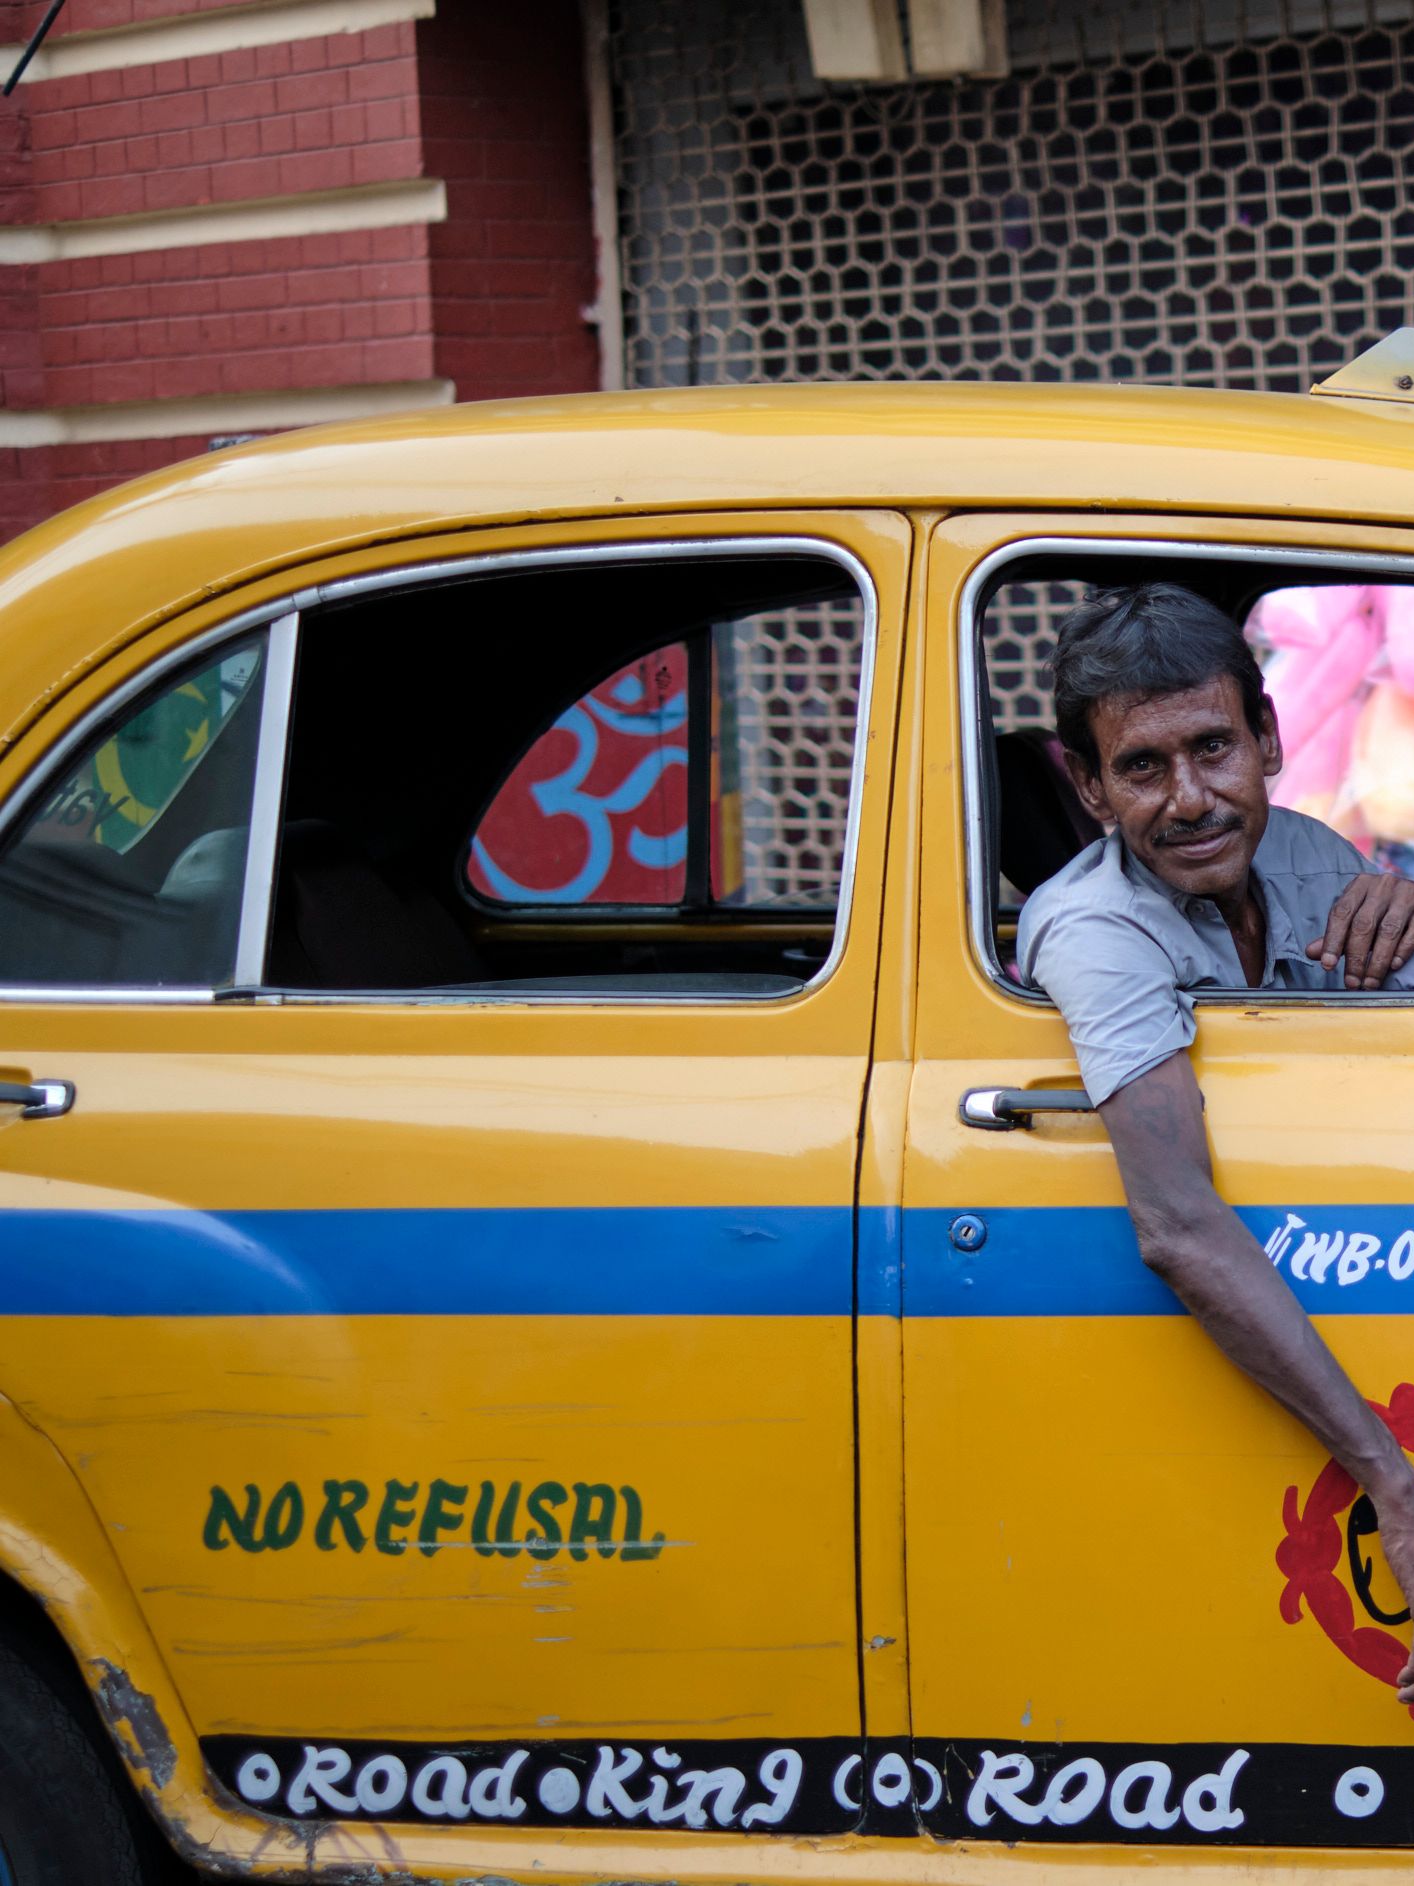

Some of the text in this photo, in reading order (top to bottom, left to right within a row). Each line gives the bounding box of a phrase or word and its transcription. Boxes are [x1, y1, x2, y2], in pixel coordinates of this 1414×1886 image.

[202, 1477, 666, 1562] NO REFUSAL
[585, 1745, 803, 1829] King
